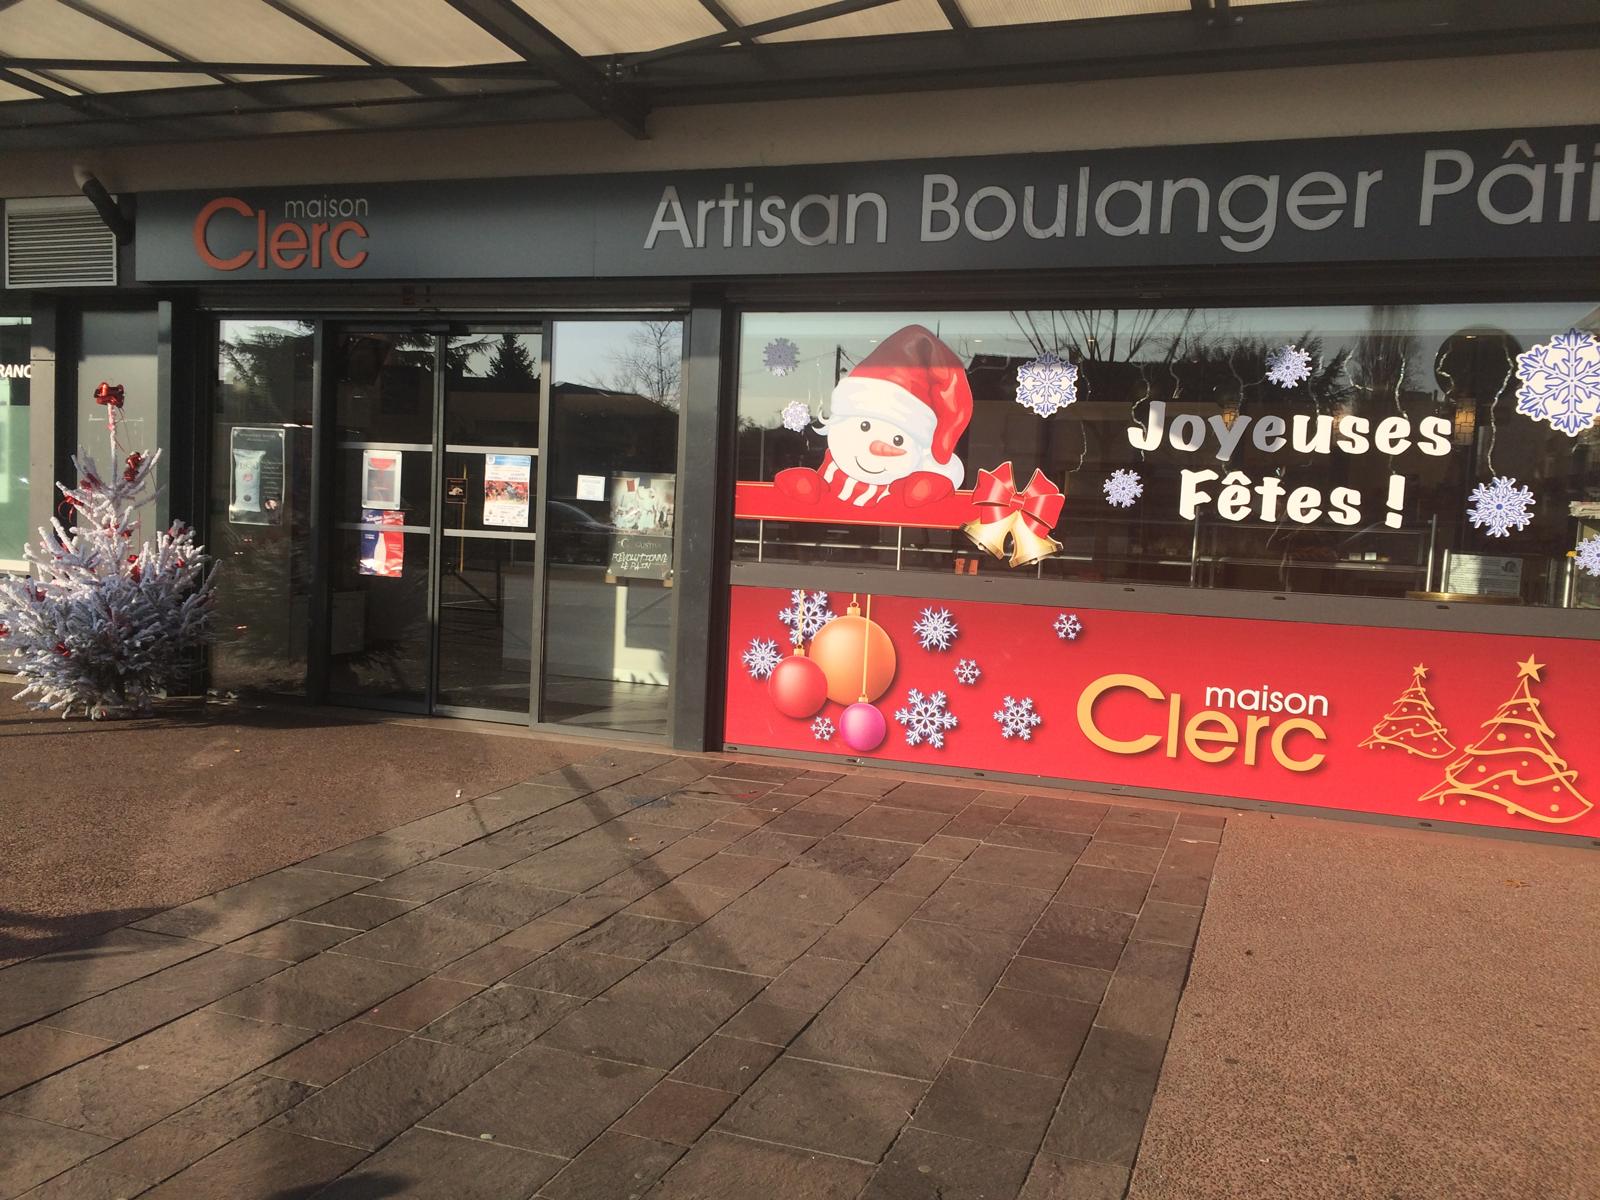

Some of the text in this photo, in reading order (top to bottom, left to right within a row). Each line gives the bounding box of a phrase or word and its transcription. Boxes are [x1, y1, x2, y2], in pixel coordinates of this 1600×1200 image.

[192, 197, 370, 271] Clerc
[284, 194, 368, 218] maison
[643, 183, 888, 249] Artisan
[920, 167, 1383, 253] Boulanger
[1127, 400, 1453, 462] Joyeuses
[1178, 468, 1362, 526] Fêtes
[1076, 673, 1328, 772] Clerc
[1204, 684, 1329, 717] maison
